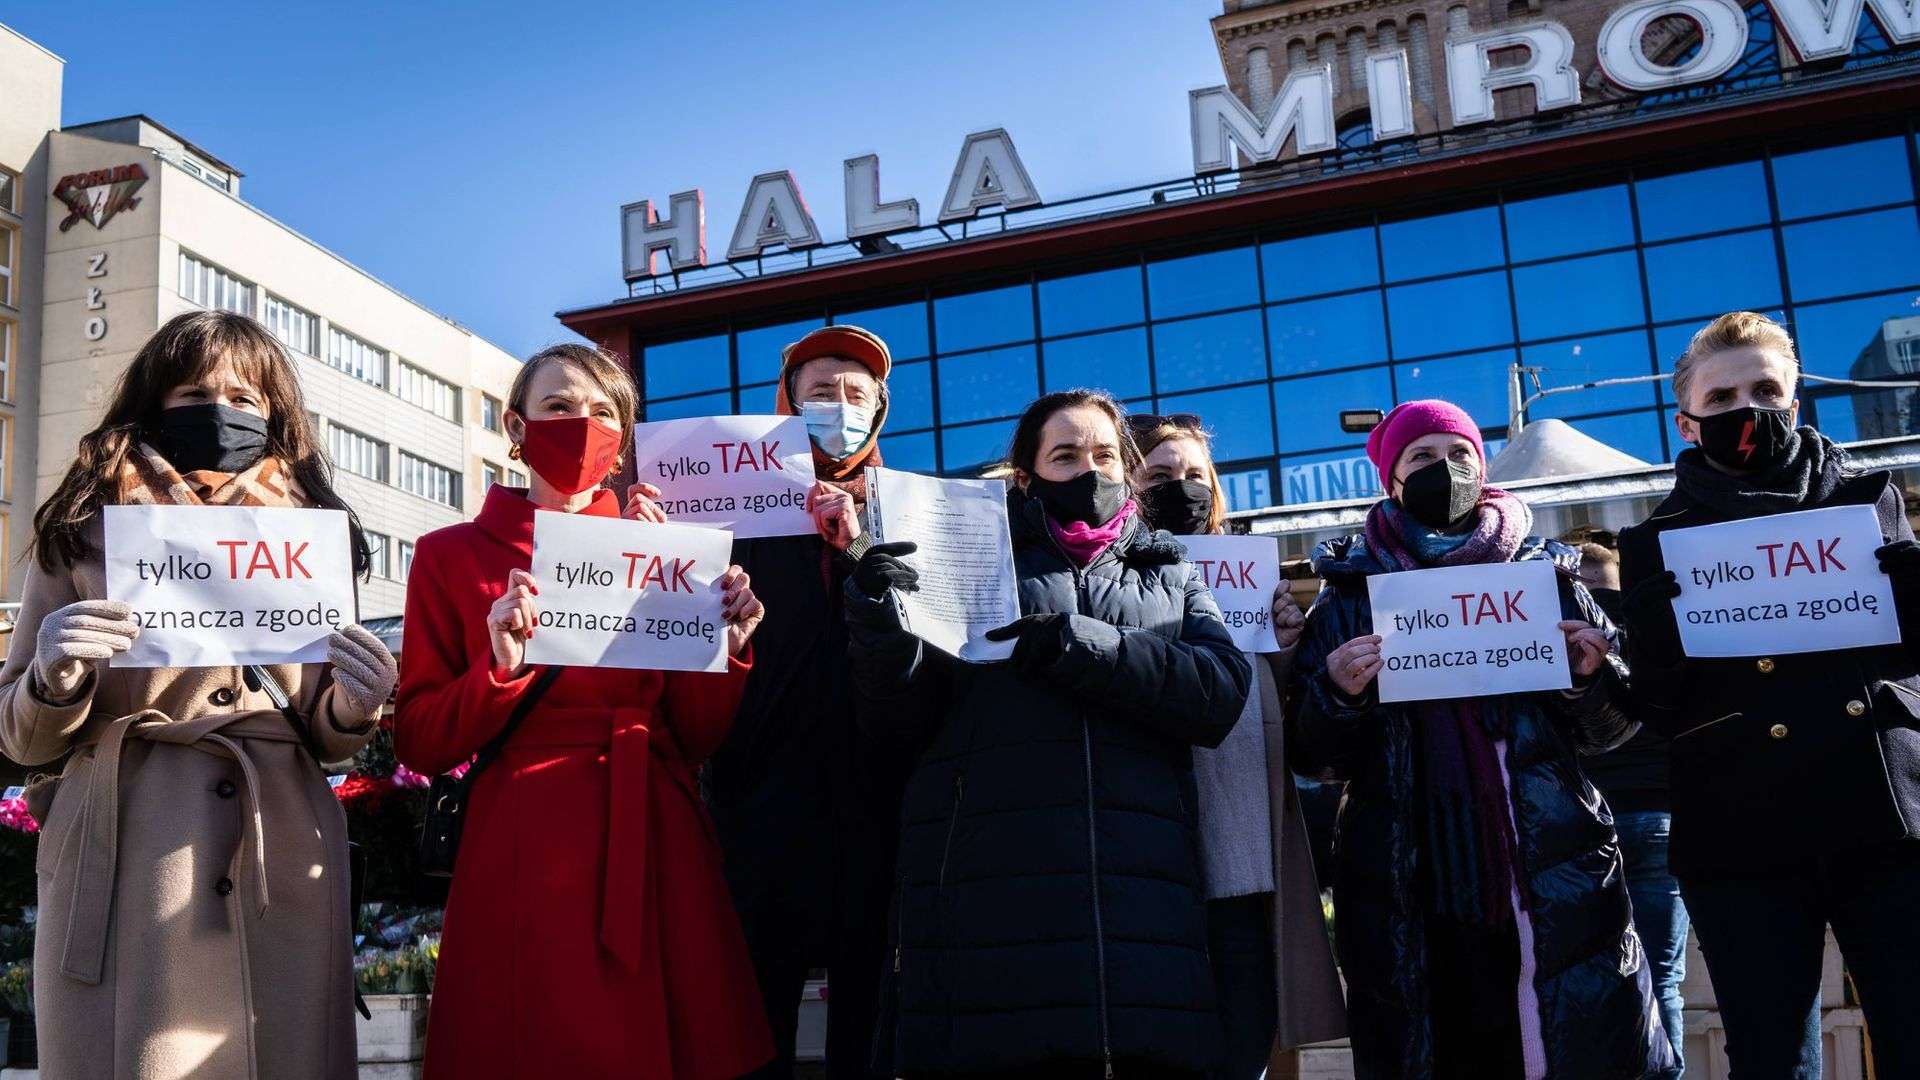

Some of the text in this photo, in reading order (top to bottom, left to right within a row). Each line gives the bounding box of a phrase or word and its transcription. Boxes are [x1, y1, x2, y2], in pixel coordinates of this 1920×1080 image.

[54, 163, 149, 194] FORUM
[620, 128, 1043, 281] HALA
[657, 440, 784, 481] tylko TAK
[743, 488, 806, 514] zgodę
[136, 540, 313, 586] tylko TAK
[555, 552, 696, 594] tylko TAK
[1195, 560, 1258, 590] TAK
[1691, 537, 1847, 589] tylko TAK
[255, 602, 341, 632] zgodę
[1393, 590, 1529, 635] tylko TAK
[1686, 590, 1879, 625] oznacza zgodę
[538, 609, 715, 643] oznacza zgodę
[1386, 640, 1554, 671] oznacza zgodę
